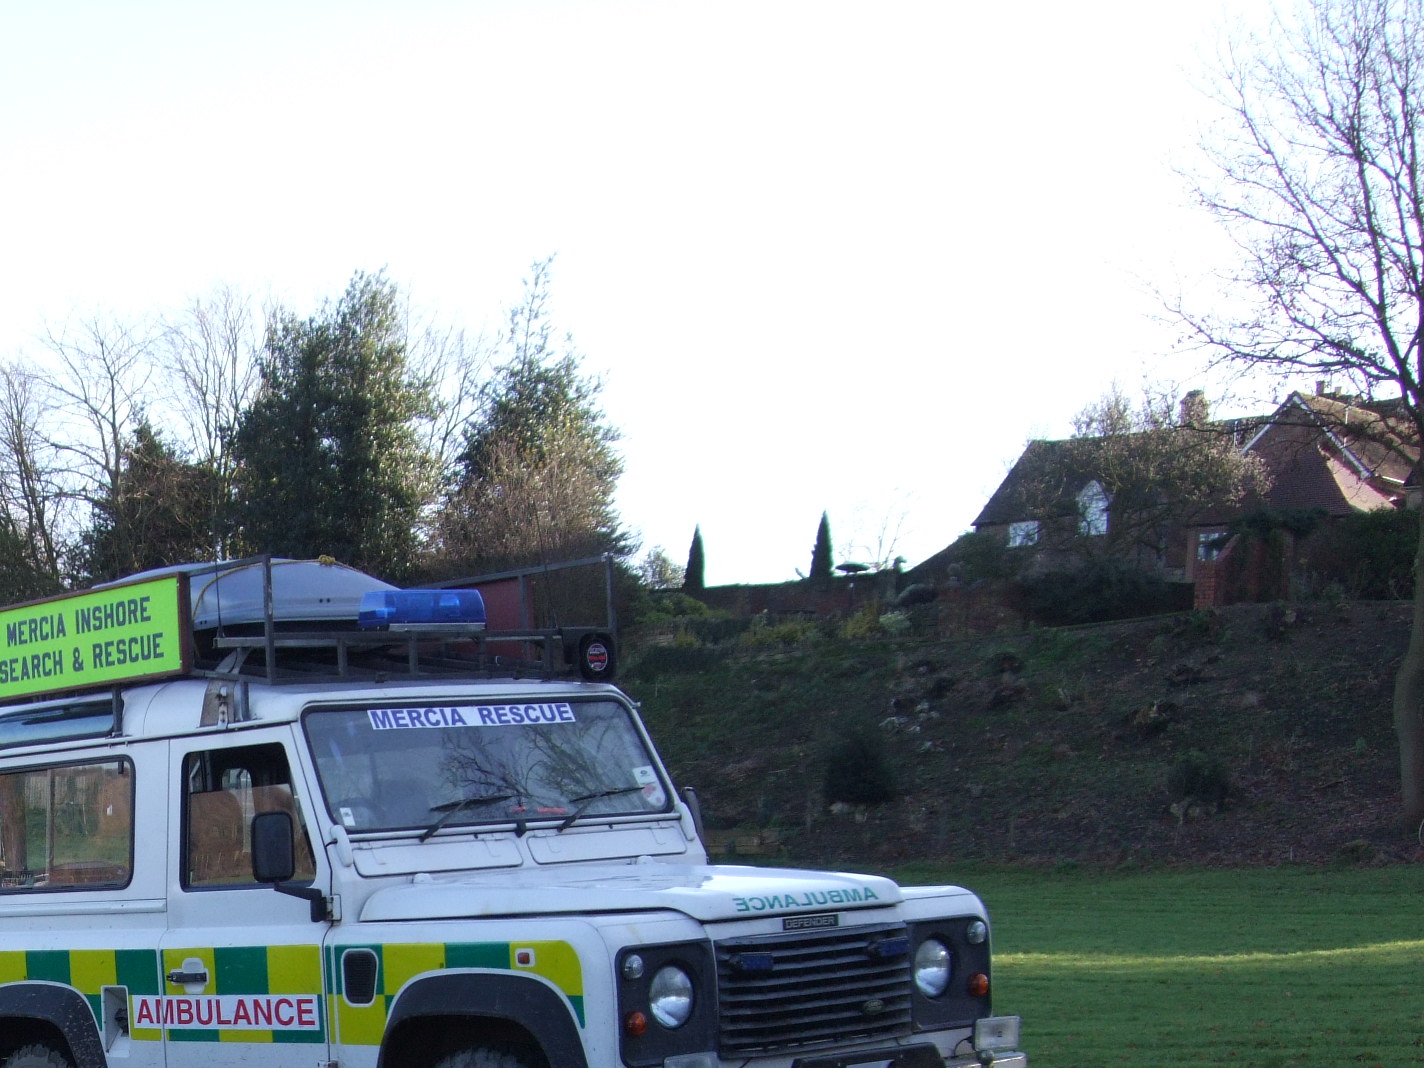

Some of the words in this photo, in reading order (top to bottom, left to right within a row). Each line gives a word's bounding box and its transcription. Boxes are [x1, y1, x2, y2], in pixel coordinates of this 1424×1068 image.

[6, 613, 66, 647] MERCIA
[75, 596, 152, 634] INSHORE
[0, 650, 63, 684] SEARCH
[72, 647, 84, 672] &
[92, 632, 164, 669] RESCUE
[371, 707, 467, 728] MERCIA
[478, 703, 573, 725] RESCUE
[785, 916, 836, 929] DEFENDER
[137, 998, 316, 1026] AMBULANCE
